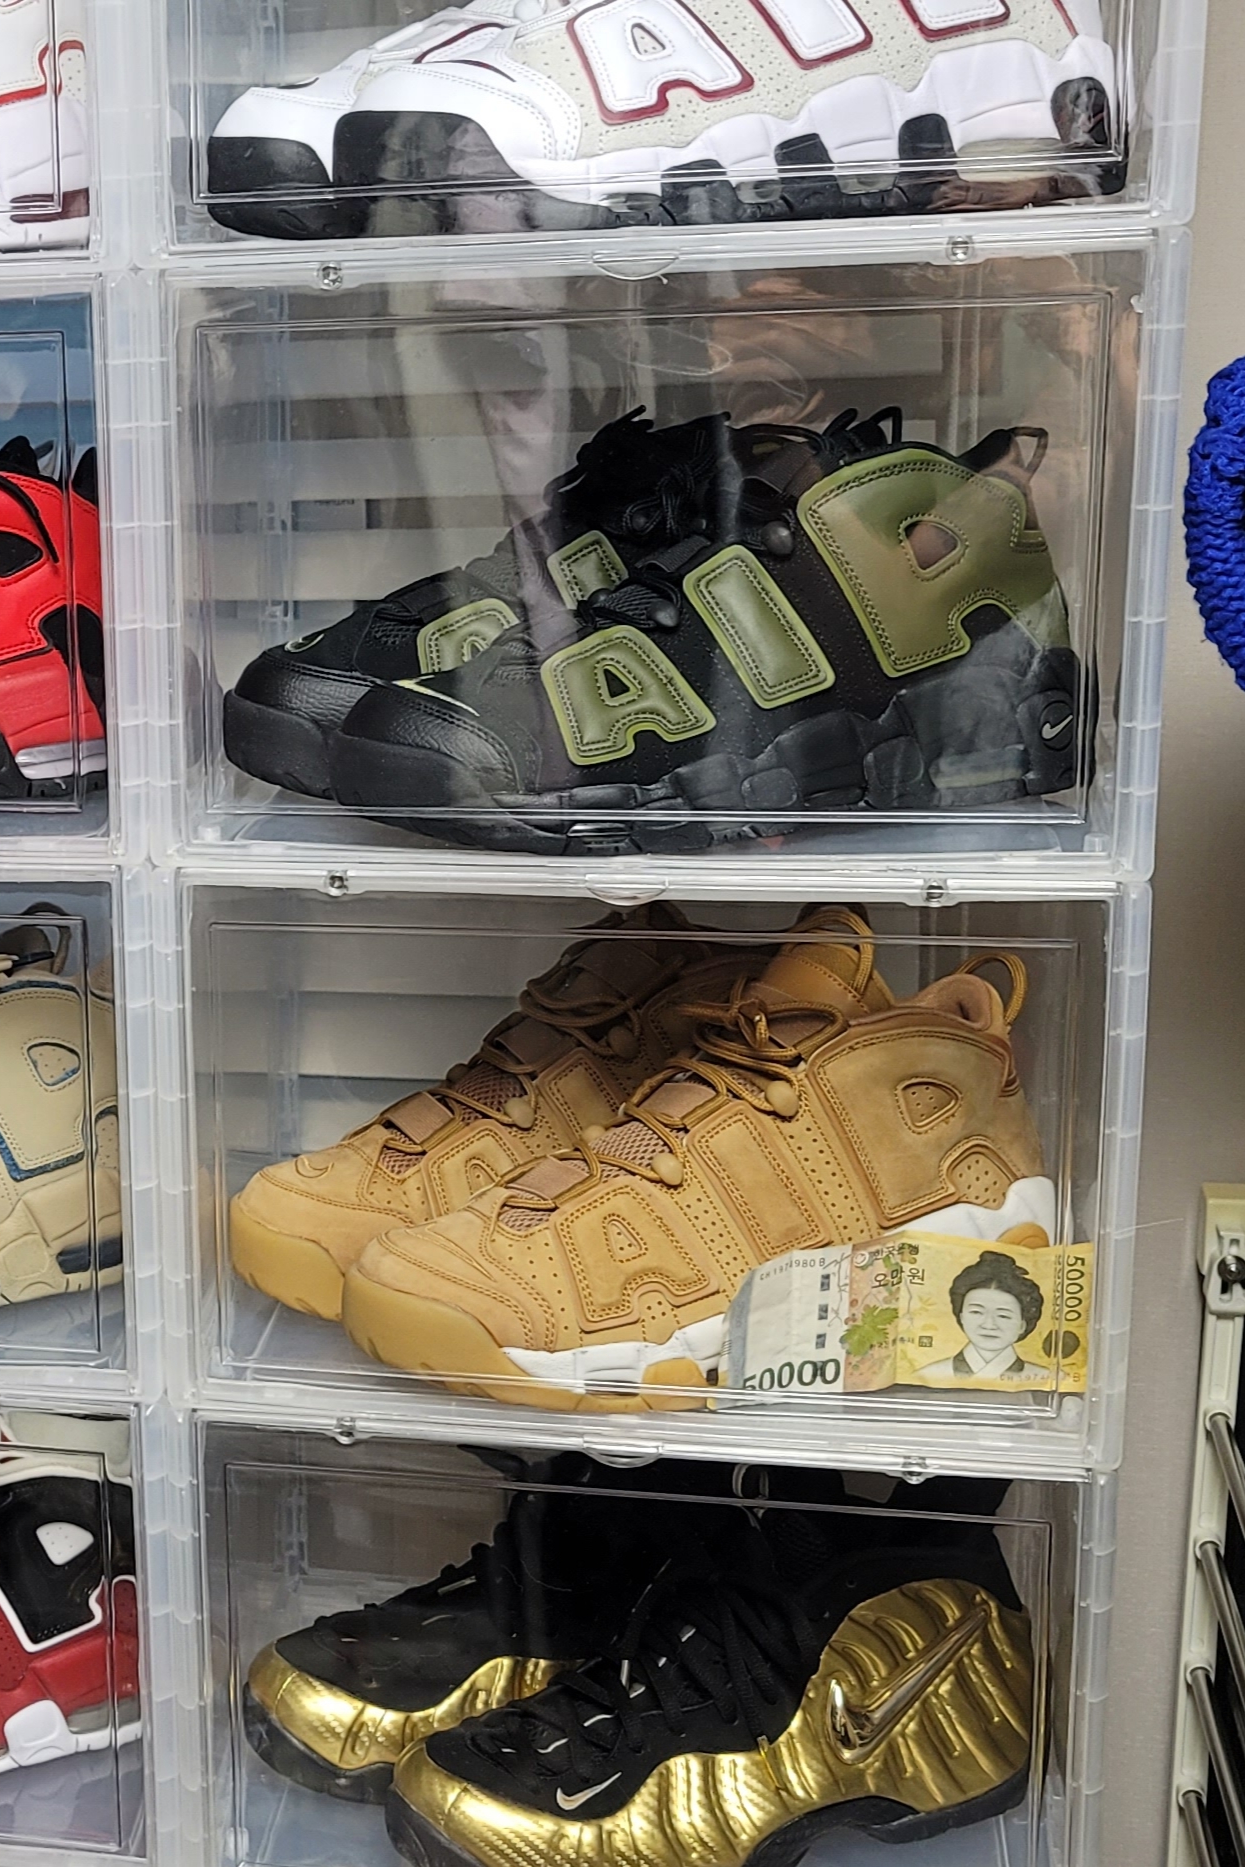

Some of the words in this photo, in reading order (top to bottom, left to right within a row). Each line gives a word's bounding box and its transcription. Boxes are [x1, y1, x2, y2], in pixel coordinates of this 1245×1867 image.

[541, 448, 1066, 766] AIR
[556, 1020, 1037, 1331] AIR
[871, 1265, 926, 1289] 오만원
[1064, 1254, 1086, 1322] 50000
